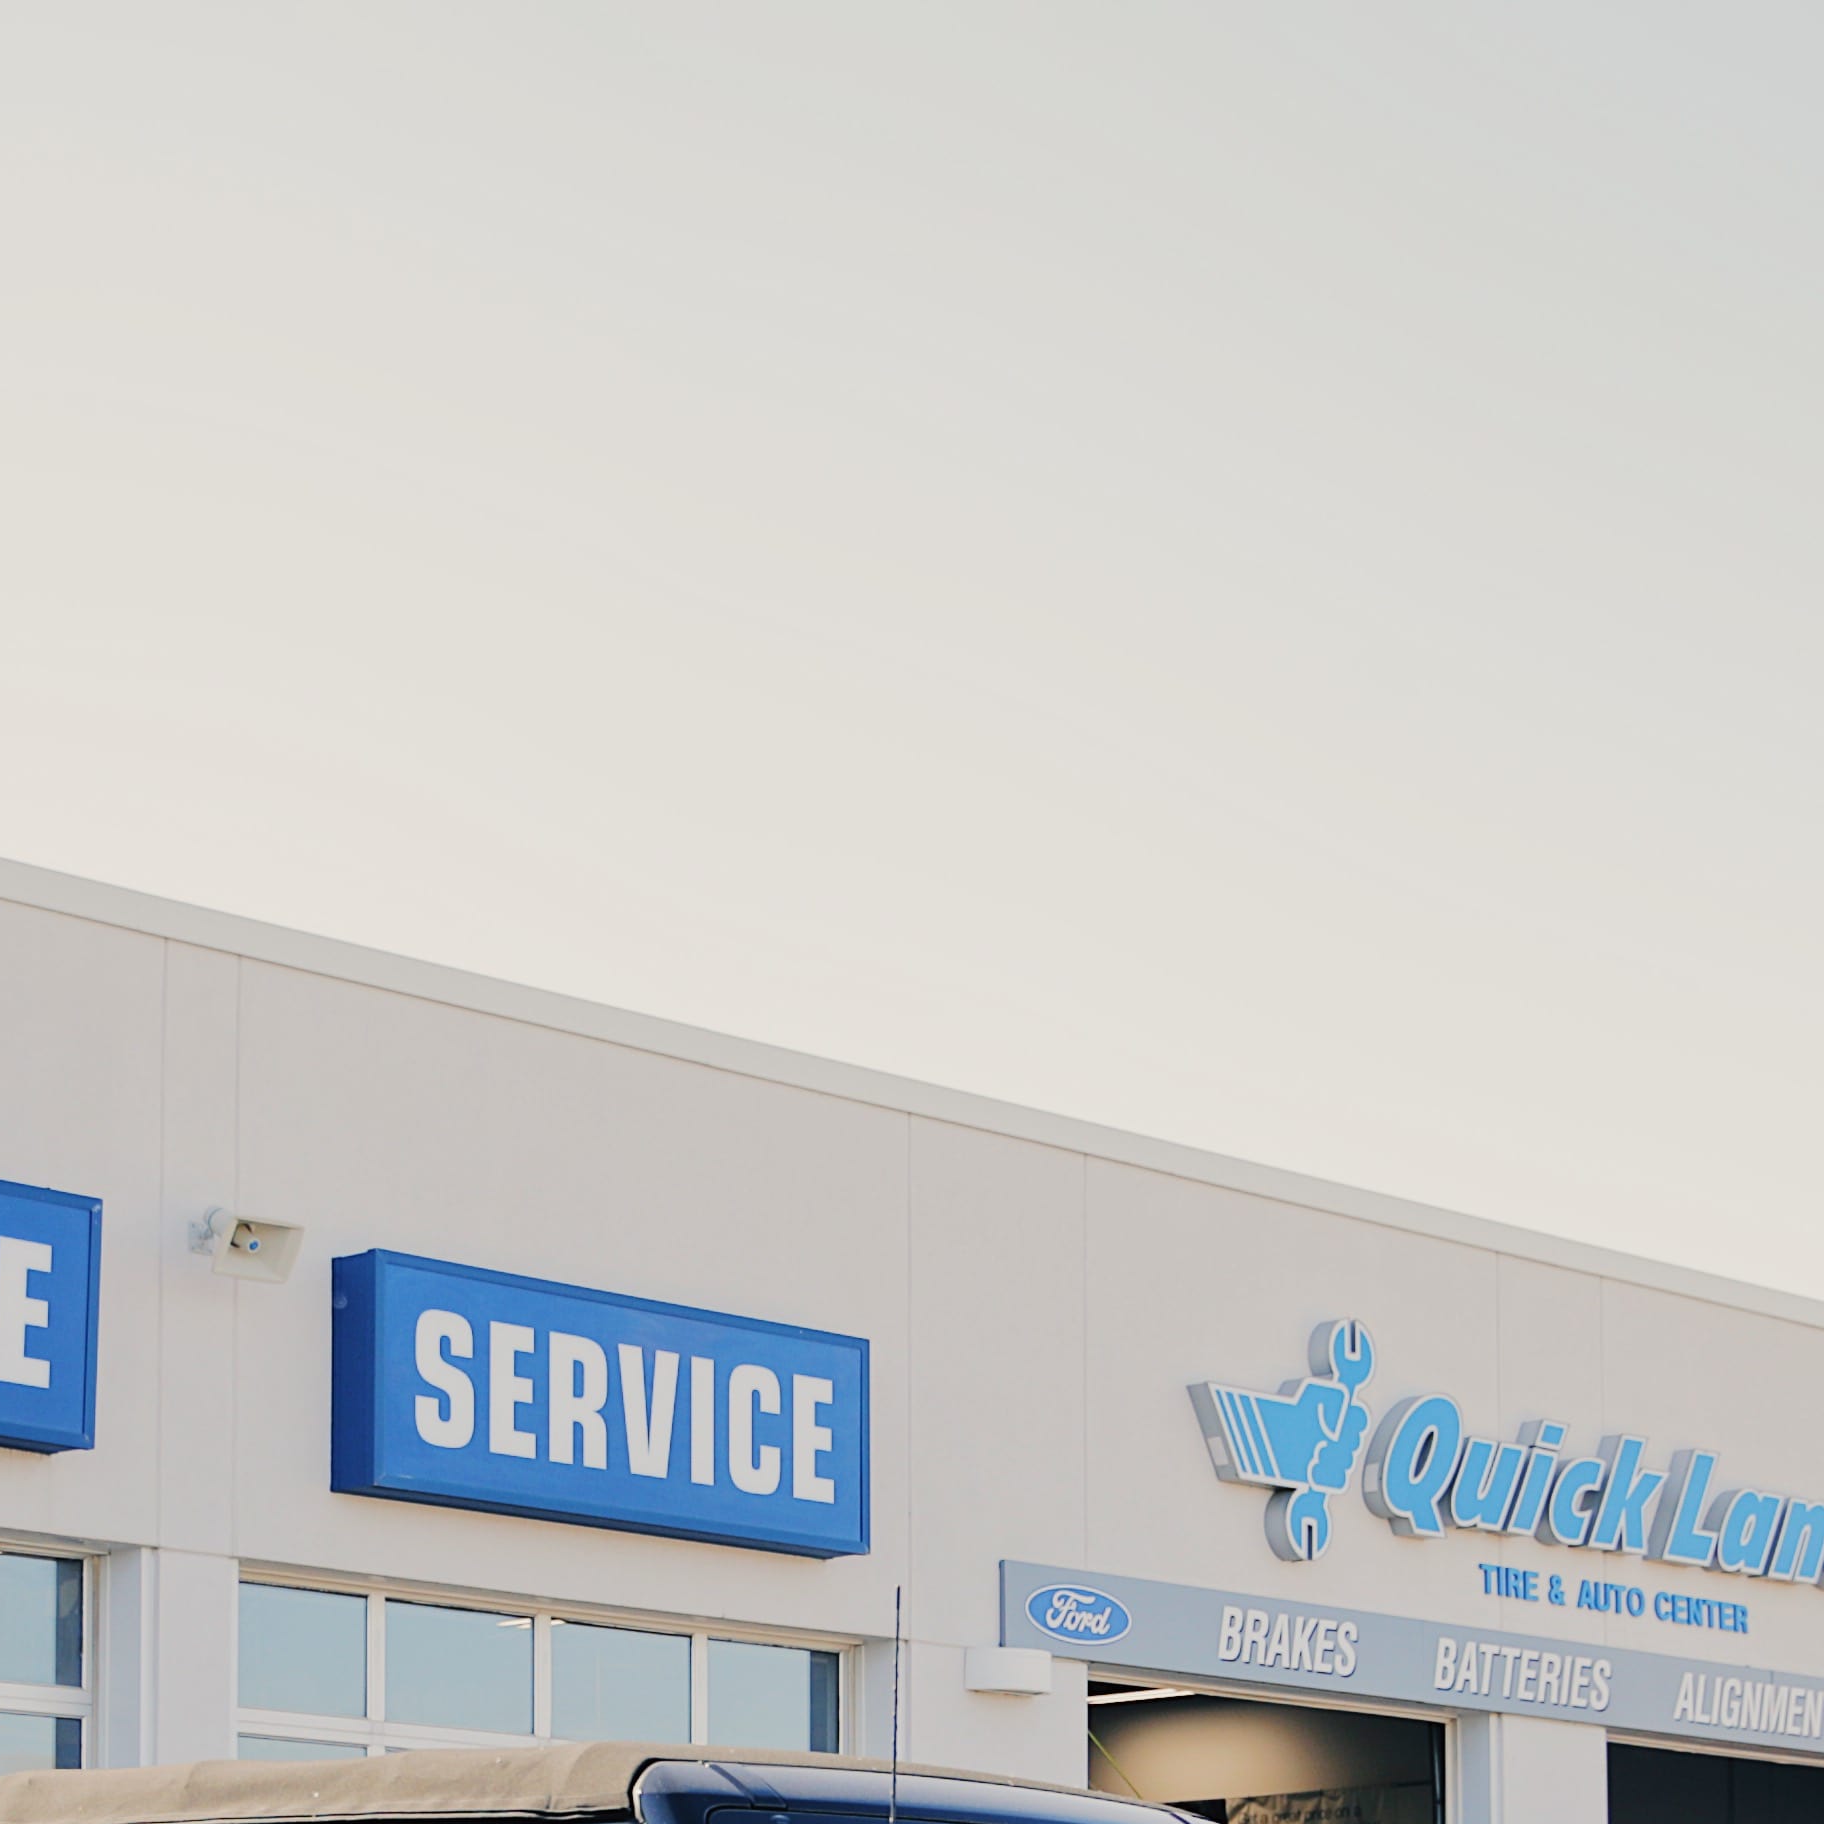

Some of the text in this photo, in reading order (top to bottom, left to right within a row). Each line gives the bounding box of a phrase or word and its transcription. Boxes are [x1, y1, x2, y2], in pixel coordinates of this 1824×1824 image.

[414, 1308, 836, 1504] SERVICE
[1370, 1393, 1674, 1555] Quick
[1042, 1587, 1115, 1637] Ford
[1478, 1563, 1749, 1635] TIRE & AUTO CENTER
[1218, 1605, 1360, 1679] BRAKES
[1432, 1635, 1613, 1713] BATTERIES
